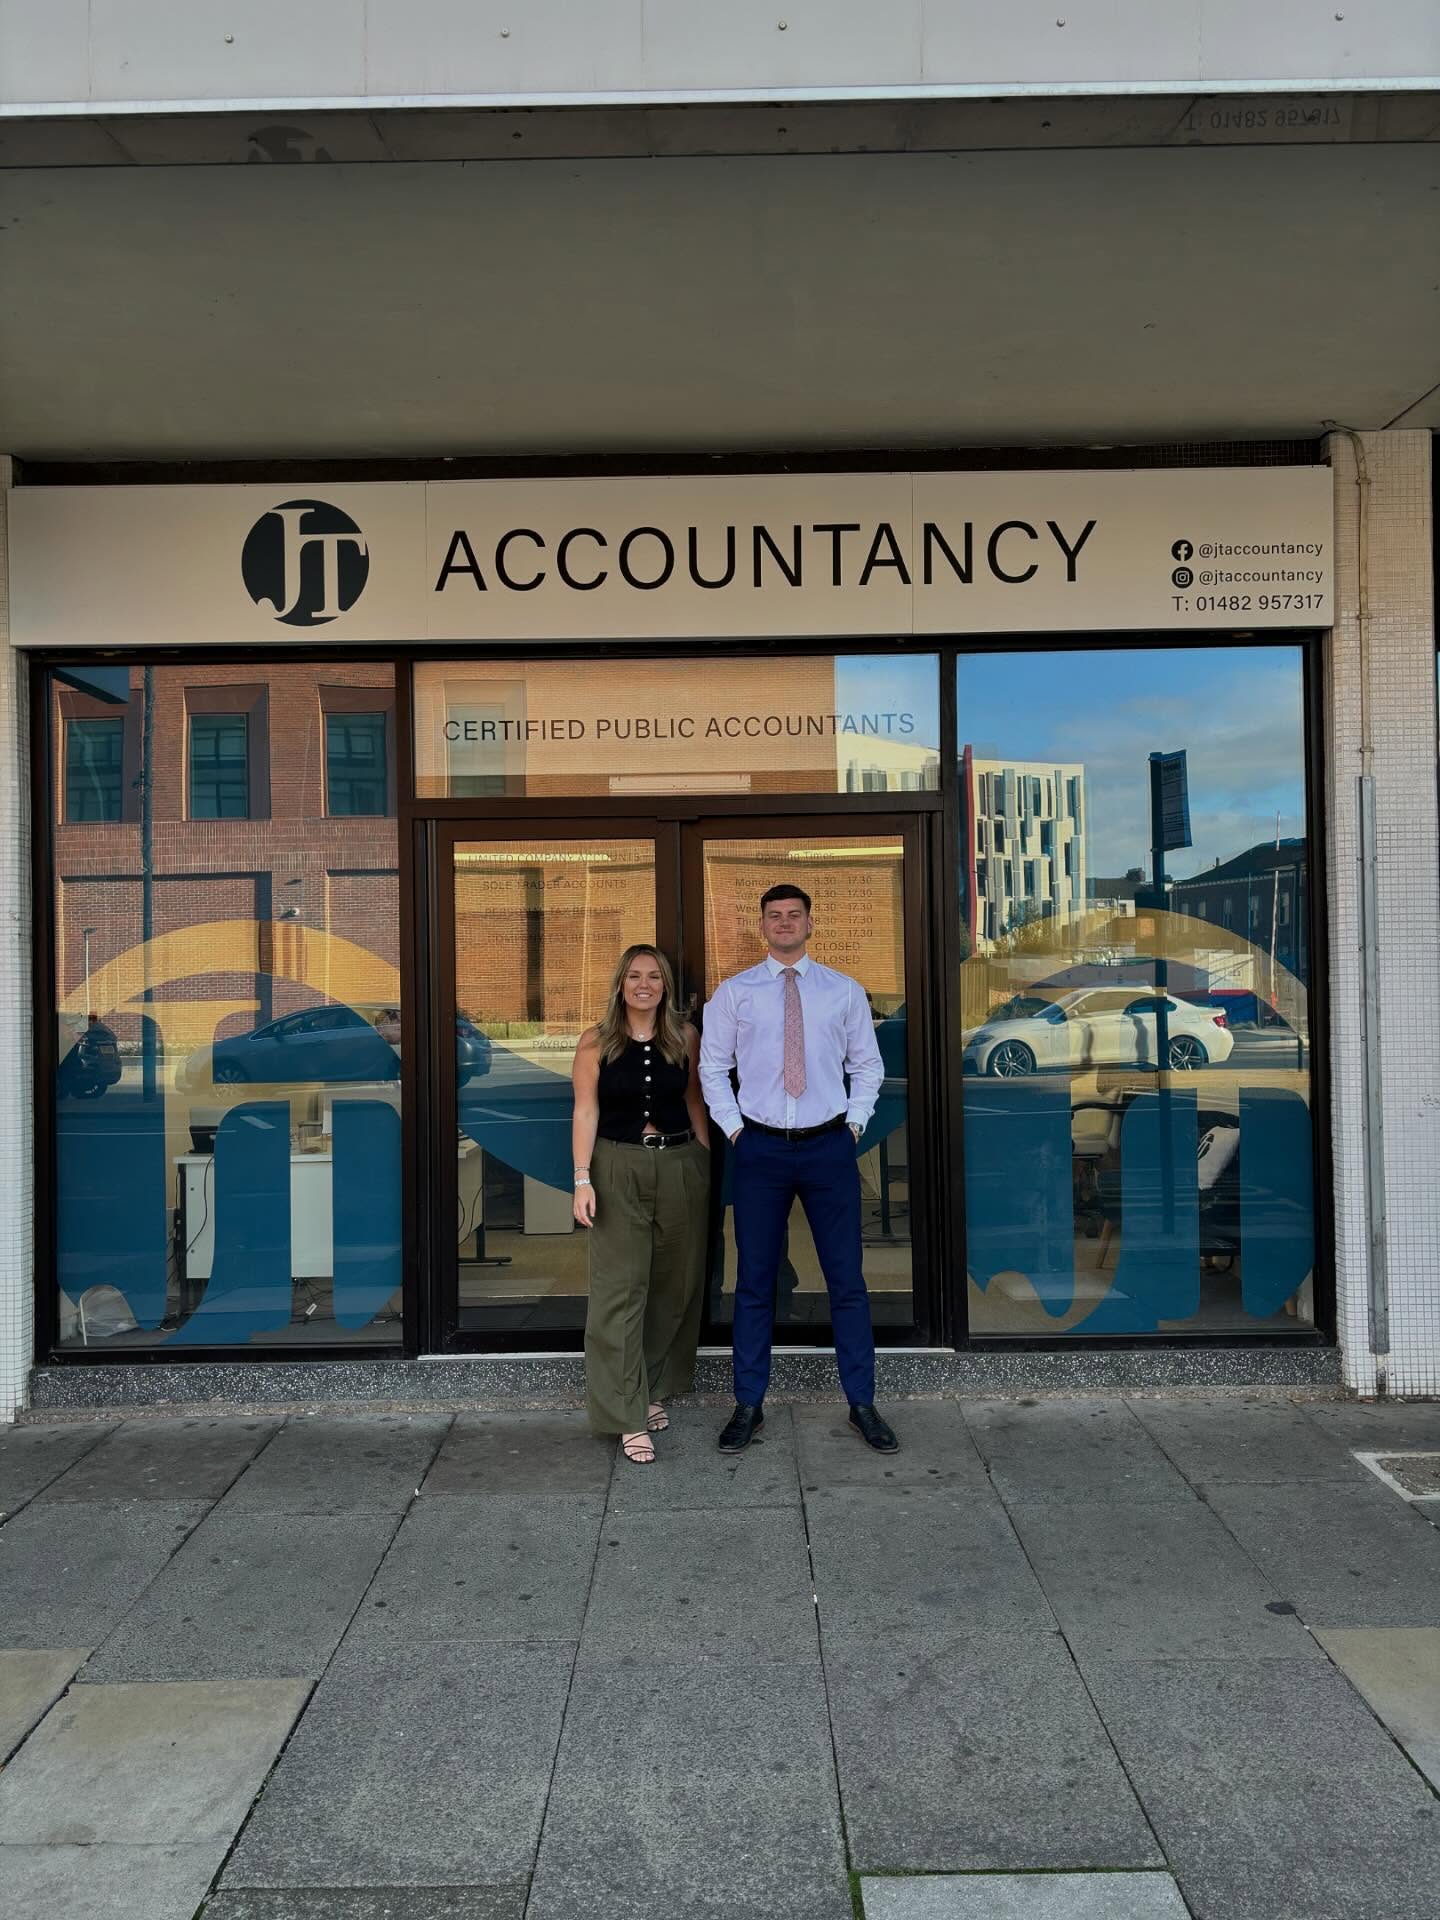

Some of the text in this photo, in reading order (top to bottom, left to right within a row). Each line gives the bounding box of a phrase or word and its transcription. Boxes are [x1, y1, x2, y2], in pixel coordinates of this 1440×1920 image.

[434, 519, 1098, 593] ACCOUNTANCY
[1198, 542, 1324, 559] @jtaccountancy
[257, 508, 367, 618] JT
[1198, 569, 1324, 586] @jtaccountancy
[1171, 594, 1325, 612] T: 01482 957317
[443, 712, 915, 742] CERTIFIED PUBLIC ACCOUNTANTS
[482, 878, 628, 891] SOLE TRADER ACCOUNTS
[735, 878, 777, 889] Monday
[815, 941, 861, 952] CLOSED
[815, 955, 861, 965] CLOSED
[532, 1040, 577, 1049] PAYROL
